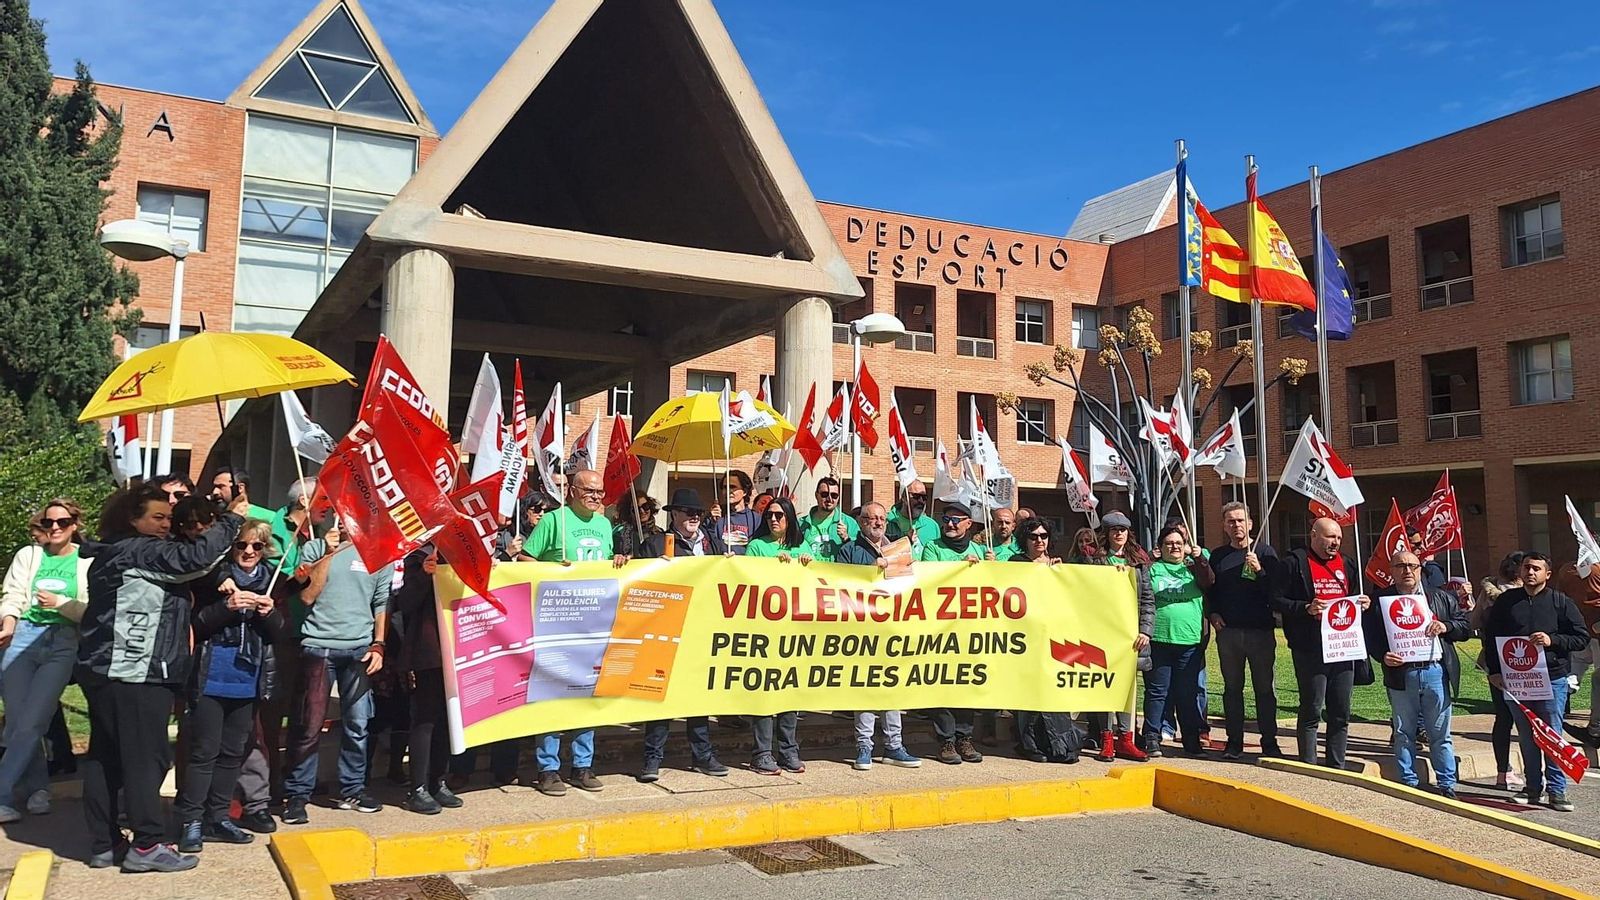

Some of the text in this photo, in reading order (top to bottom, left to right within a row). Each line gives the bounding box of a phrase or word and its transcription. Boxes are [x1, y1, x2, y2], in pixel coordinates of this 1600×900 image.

[847, 216, 1069, 272] D'EDUCACIÓ
[867, 249, 1007, 291] ESPORT
[381, 368, 434, 419] CCOO
[348, 419, 406, 508] CCOO
[543, 588, 606, 597] AULES LLIURES
[628, 588, 684, 600] RESPECTEM-NOS
[541, 596, 599, 606] DE VIOLÈNCIA
[717, 578, 1027, 624] VIOLÈNCIA ZERO
[1331, 617, 1351, 627] PROU!
[1395, 615, 1421, 625] PROU!
[1328, 631, 1358, 641] AGRESSIONS
[1393, 631, 1427, 640] AGRESSION
[711, 632, 1027, 659] PER UN BON CLIMA DINS
[1342, 640, 1359, 648] AULES
[1411, 639, 1432, 648] AULES
[1508, 657, 1533, 666] PROU!
[707, 663, 988, 692] I FORA DE LES AULES
[1056, 670, 1115, 689] STEPV
[1506, 672, 1543, 680] AGRESSIONS
[1523, 680, 1544, 688] AULES
